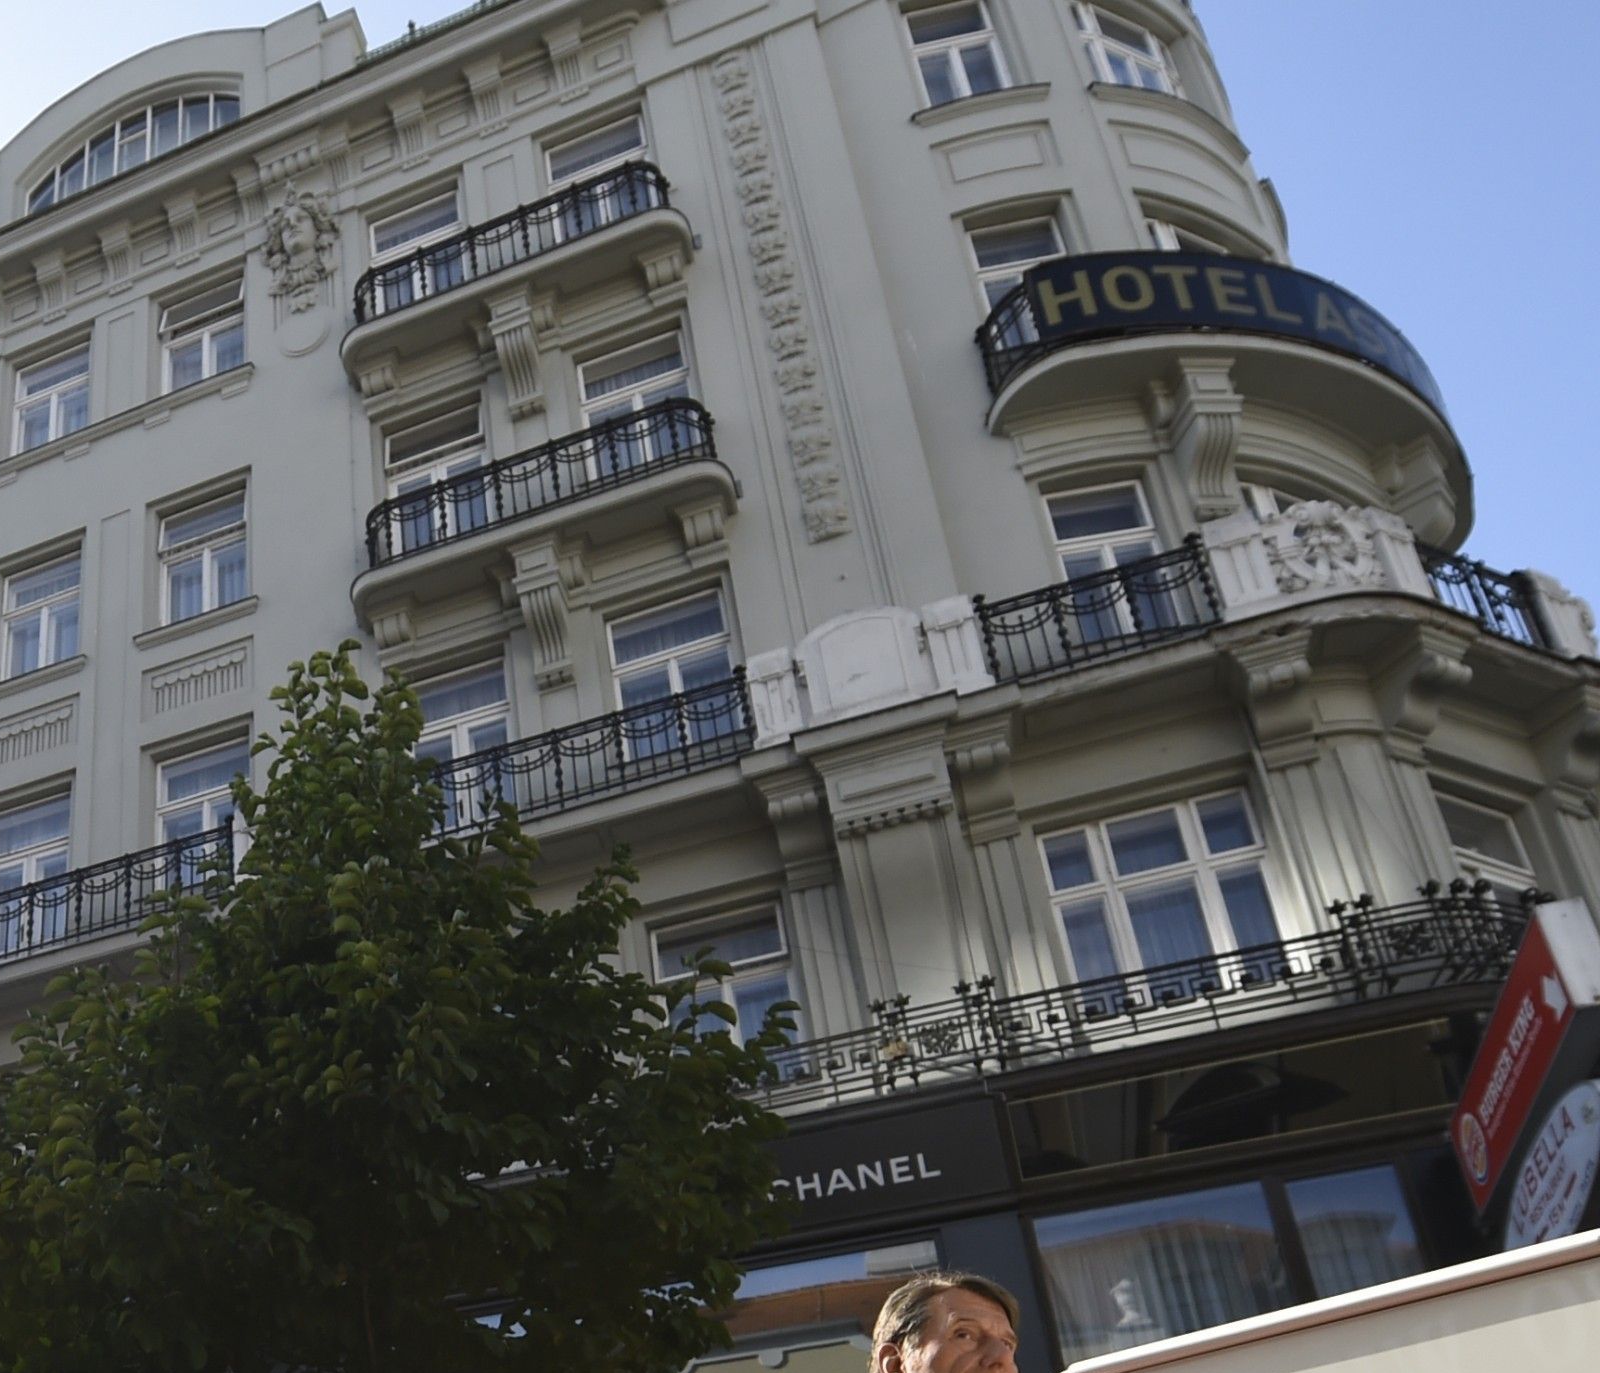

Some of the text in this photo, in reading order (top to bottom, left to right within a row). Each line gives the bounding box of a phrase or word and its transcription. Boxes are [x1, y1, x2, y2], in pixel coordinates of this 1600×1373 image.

[1036, 264, 1302, 326] HOTEL
[1508, 993, 1536, 1056] KING
[1511, 1105, 1576, 1236] LUBELLA
